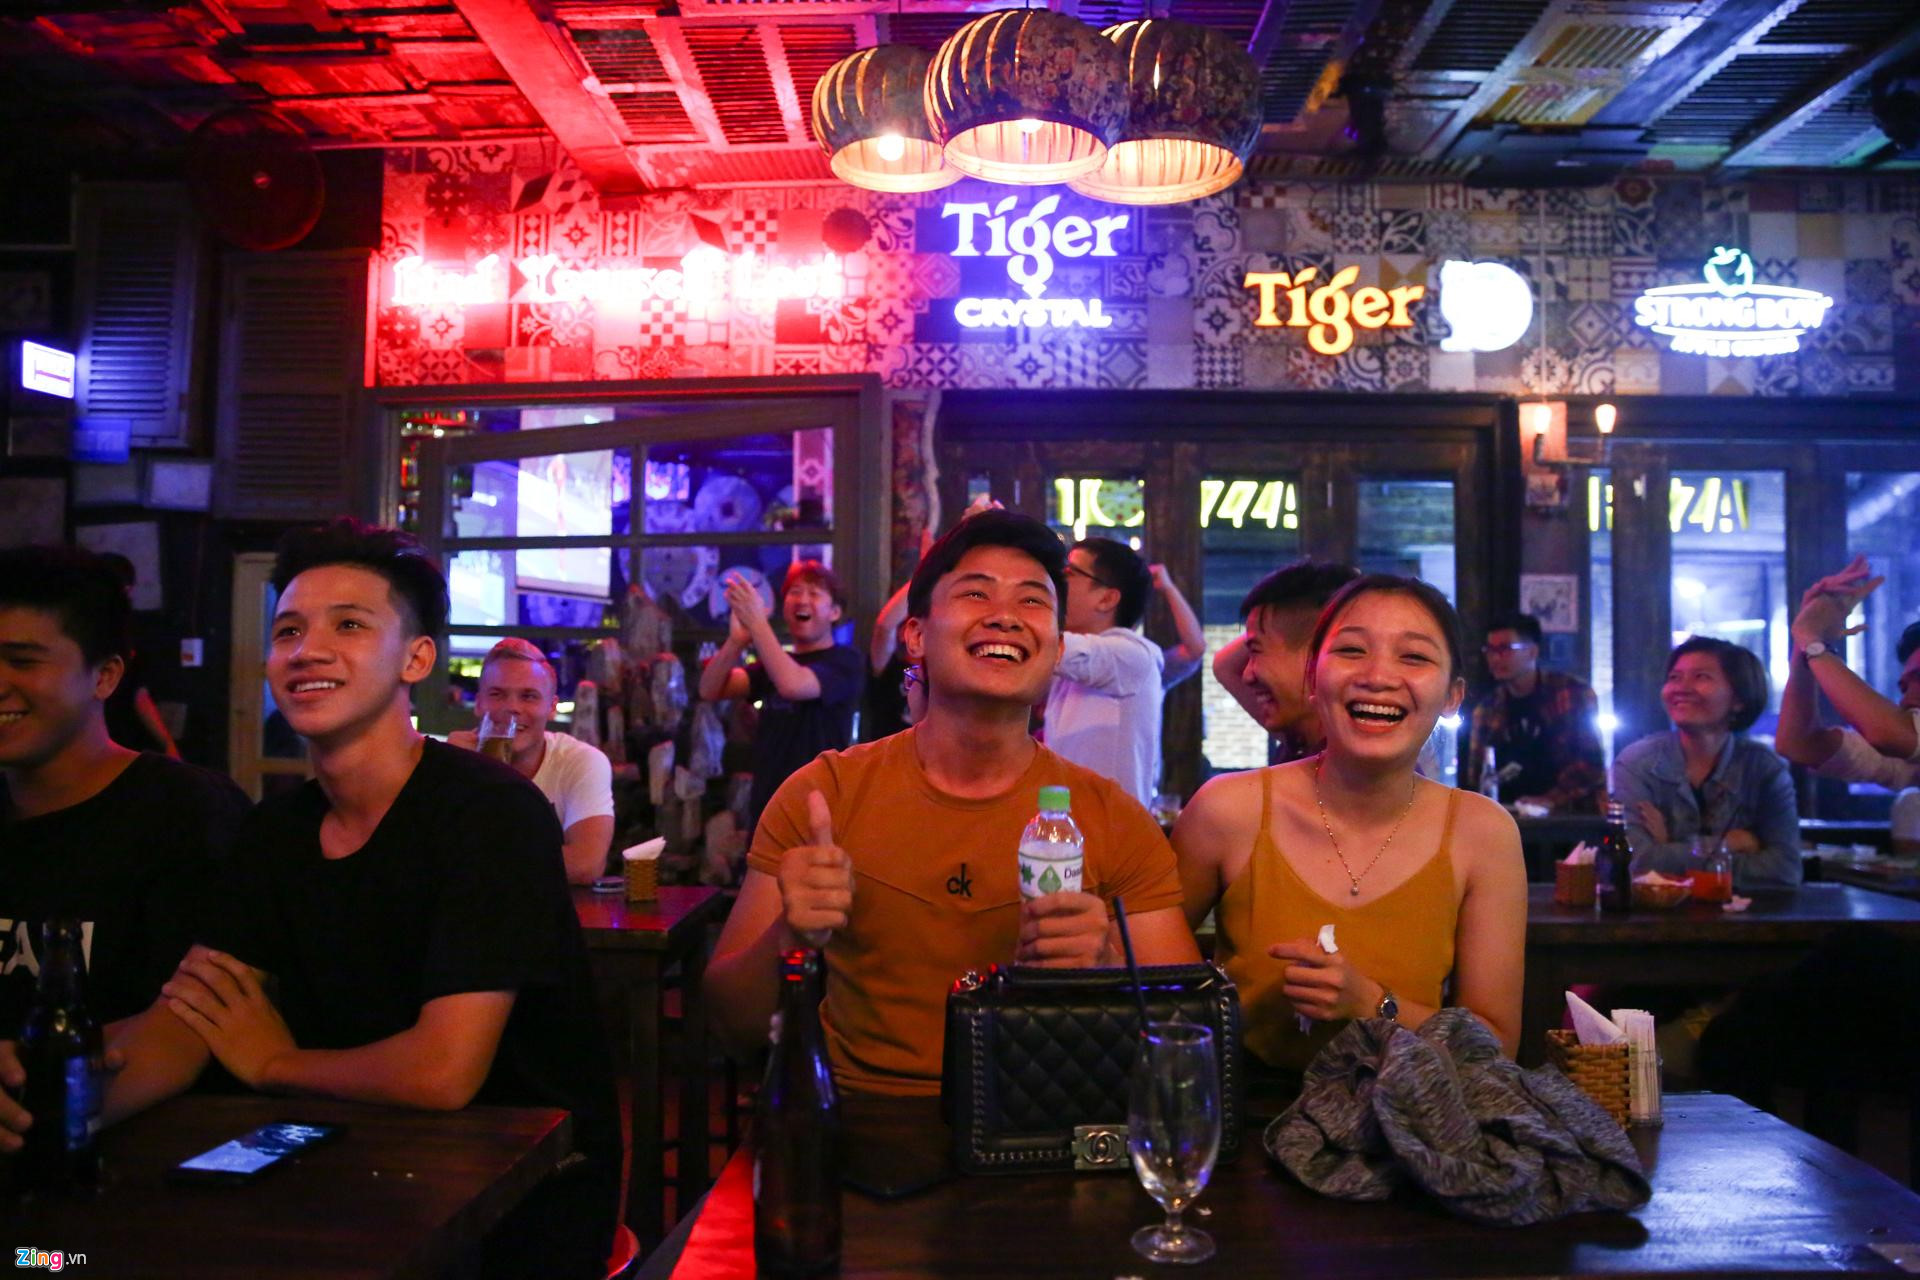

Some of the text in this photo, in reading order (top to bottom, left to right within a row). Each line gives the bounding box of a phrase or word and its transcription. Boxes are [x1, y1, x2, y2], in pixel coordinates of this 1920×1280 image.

[941, 194, 1130, 288] Tiger
[954, 298, 1113, 328] CRYSTAL
[1244, 266, 1425, 355] Tiger
[946, 863, 973, 898] ck
